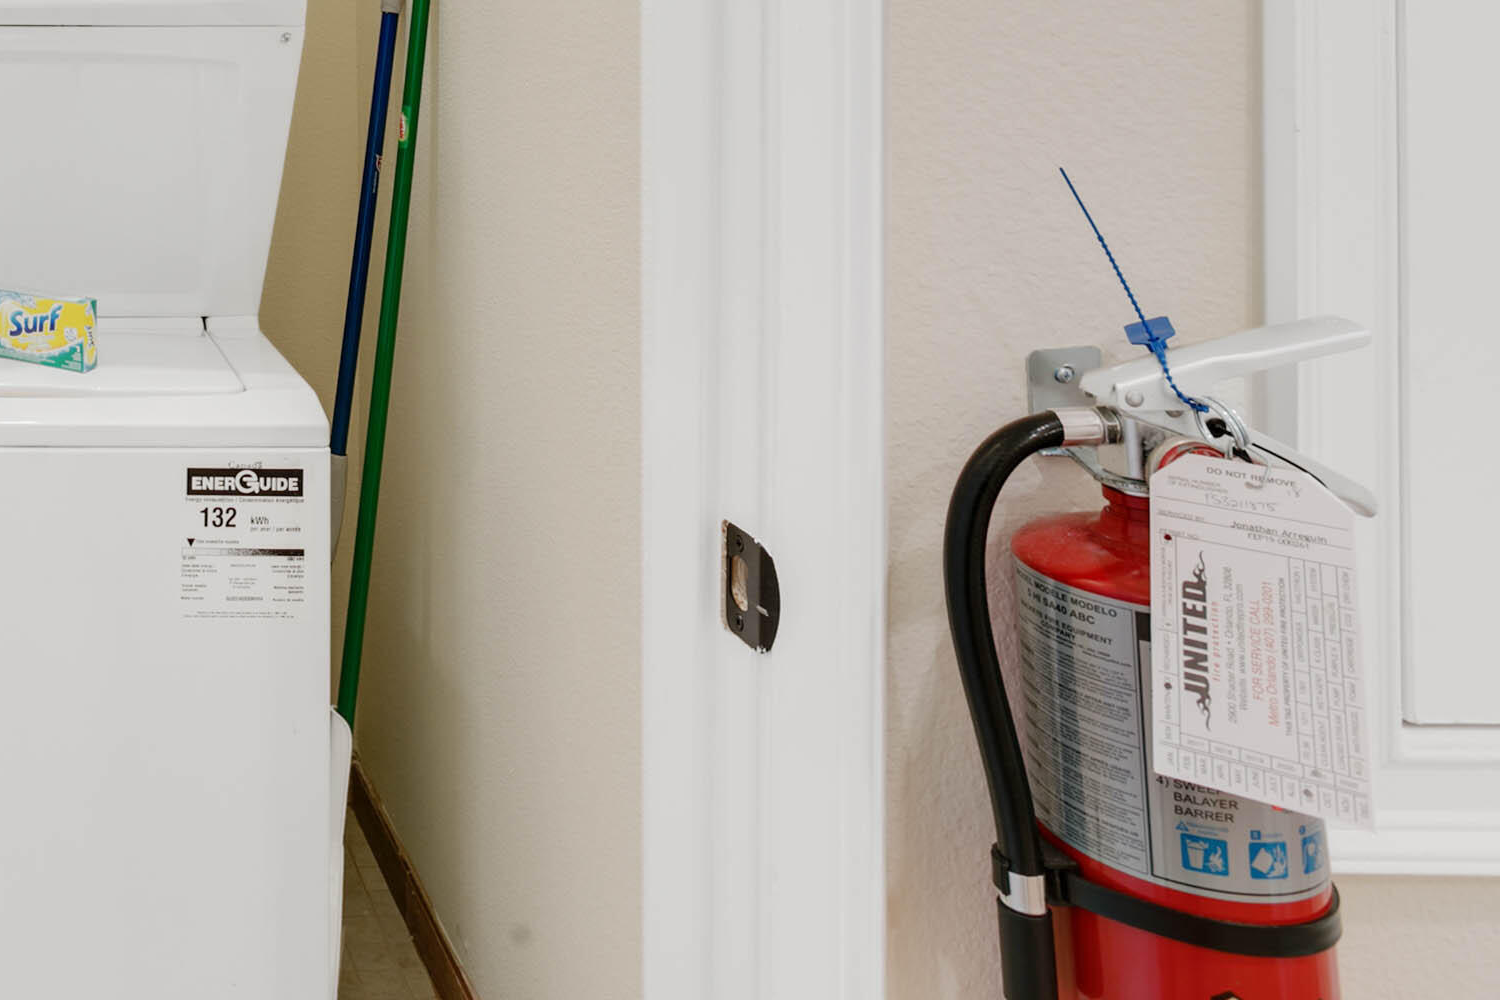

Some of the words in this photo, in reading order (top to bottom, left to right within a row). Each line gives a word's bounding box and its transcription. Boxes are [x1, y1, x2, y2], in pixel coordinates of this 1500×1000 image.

[9, 305, 63, 336] Surf
[191, 470, 299, 494] ENERGUIDE
[1206, 467, 1222, 476] DO
[1225, 470, 1247, 480] NOT
[1251, 474, 1297, 487] REMOVE
[200, 507, 237, 528] 132
[1070, 596, 1117, 618] MODELO
[1070, 609, 1095, 625] ABC
[1249, 599, 1261, 625] CALL
[1182, 578, 1211, 699] UNITED
[1250, 627, 1263, 675] SERVICE
[1252, 678, 1264, 701] FOR
[1173, 791, 1239, 810] BALAYER
[1173, 804, 1235, 824] BARRER
